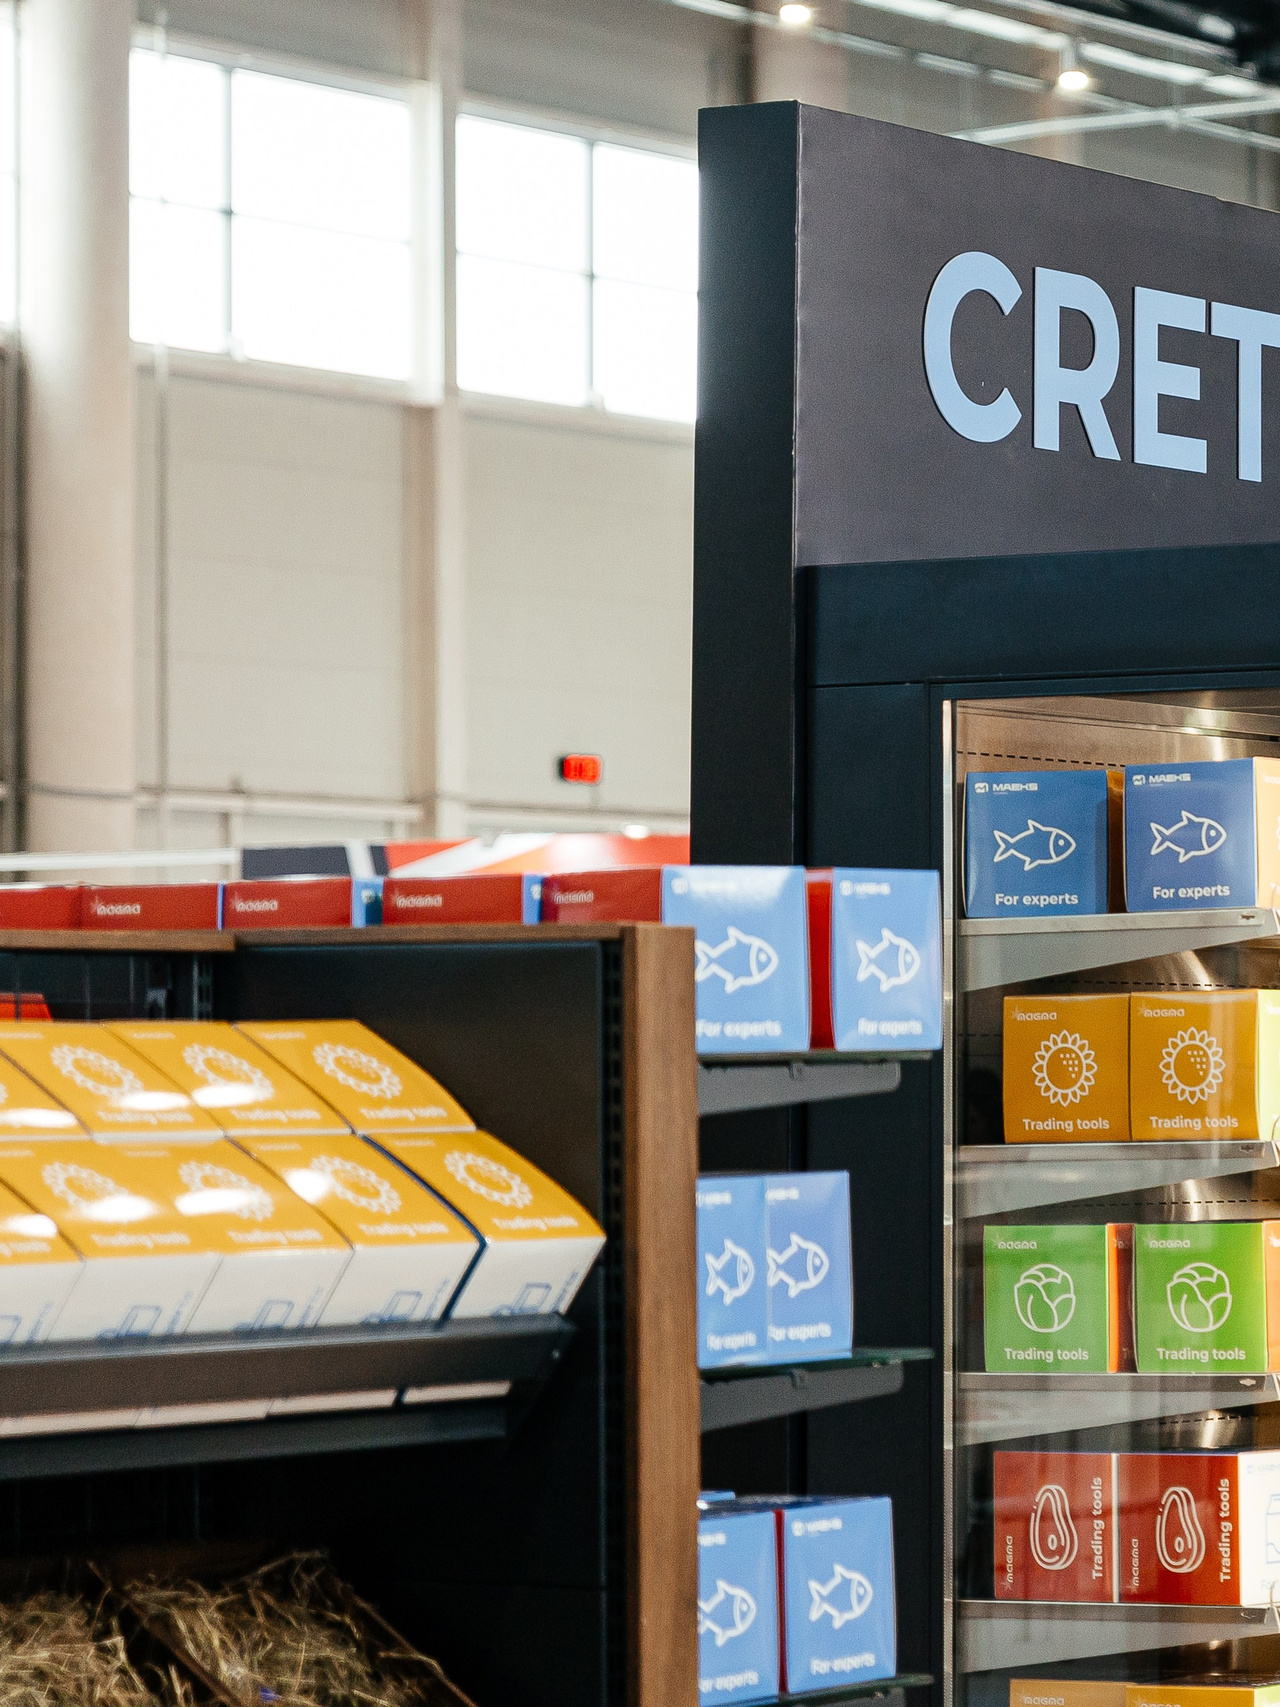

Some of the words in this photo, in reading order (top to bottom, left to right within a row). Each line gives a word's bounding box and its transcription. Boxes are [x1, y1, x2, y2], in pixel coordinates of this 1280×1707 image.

[995, 893, 1019, 905] For
[1022, 892, 1078, 908] experts
[1153, 886, 1175, 899] For
[1178, 884, 1230, 900] experts
[724, 1020, 782, 1040] experts
[858, 1018, 878, 1035] For
[880, 1019, 922, 1038] experts
[1023, 1118, 1074, 1133] Trading
[1076, 1118, 1110, 1130] tools
[1150, 1116, 1201, 1131] Trading
[1205, 1116, 1239, 1128] tools
[787, 1323, 831, 1341] experts
[1004, 1347, 1054, 1363] Trading
[1057, 1348, 1089, 1361] tools
[1157, 1347, 1209, 1363] Trading
[1212, 1347, 1246, 1360] tools
[1091, 1477, 1102, 1516] tools
[1218, 1478, 1230, 1518] tools
[1092, 1523, 1105, 1580] Trading
[1219, 1523, 1233, 1583] Trading
[810, 1657, 832, 1675] For
[832, 1652, 875, 1672] experts
[699, 1678, 713, 1693] or
[714, 1671, 759, 1690] experts
